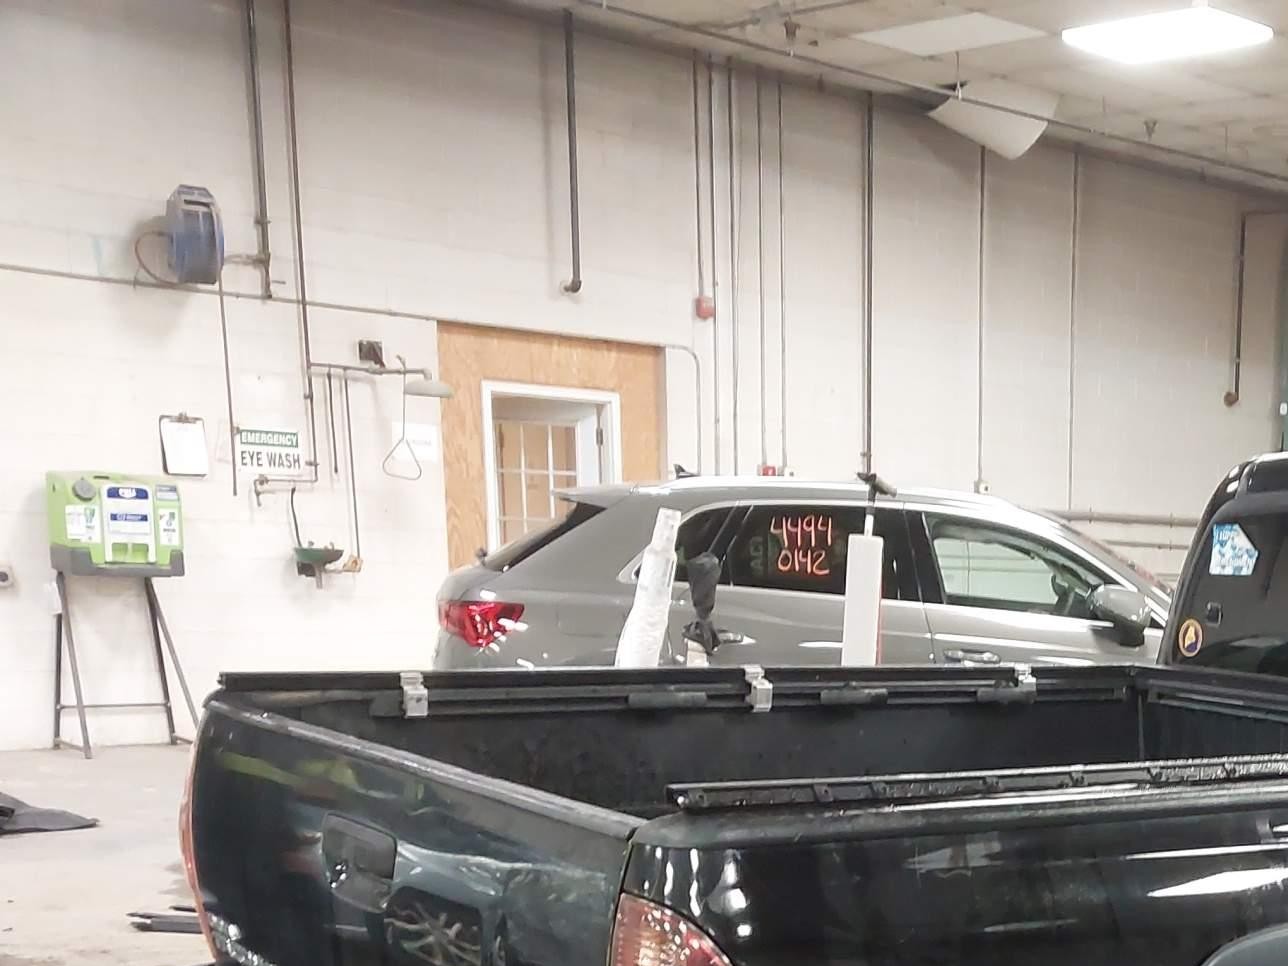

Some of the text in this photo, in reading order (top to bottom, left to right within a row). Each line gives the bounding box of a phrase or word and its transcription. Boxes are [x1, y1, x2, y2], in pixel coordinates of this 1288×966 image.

[241, 431, 297, 446] EMERGENCY
[240, 451, 301, 469] EYE WASH
[770, 515, 832, 548] 4494
[777, 548, 830, 575] 0142
